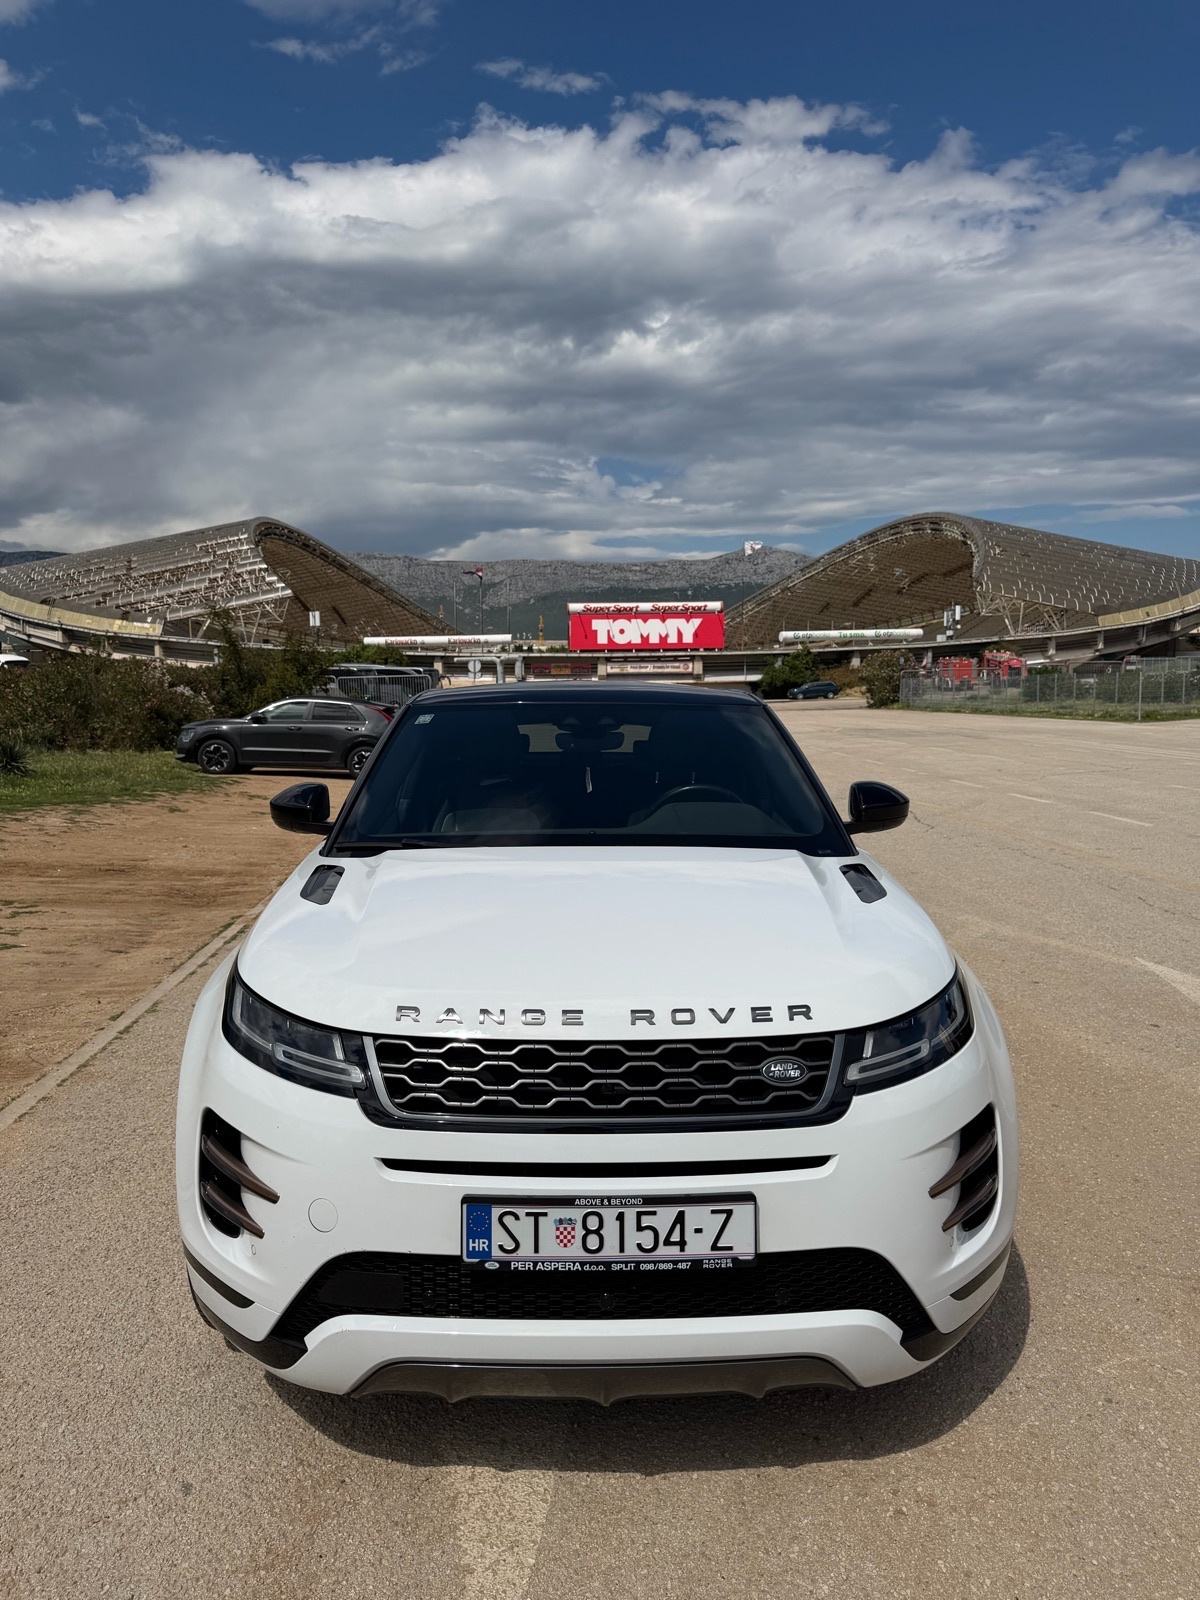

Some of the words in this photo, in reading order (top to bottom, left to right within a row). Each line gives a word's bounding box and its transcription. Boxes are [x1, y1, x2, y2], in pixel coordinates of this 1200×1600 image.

[592, 618, 703, 644] TOMMY
[396, 1005, 584, 1026] RANGE
[630, 1004, 813, 1026] ROVER
[610, 1198, 643, 1206] BEYOND
[498, 1210, 548, 1255] ST
[581, 1208, 734, 1254] 8154-Z
[469, 1239, 489, 1252] HR
[510, 1261, 533, 1271] PER
[536, 1262, 581, 1271] ASPERA
[611, 1263, 636, 1271] SPLIT
[640, 1262, 691, 1270] 098/869-487
